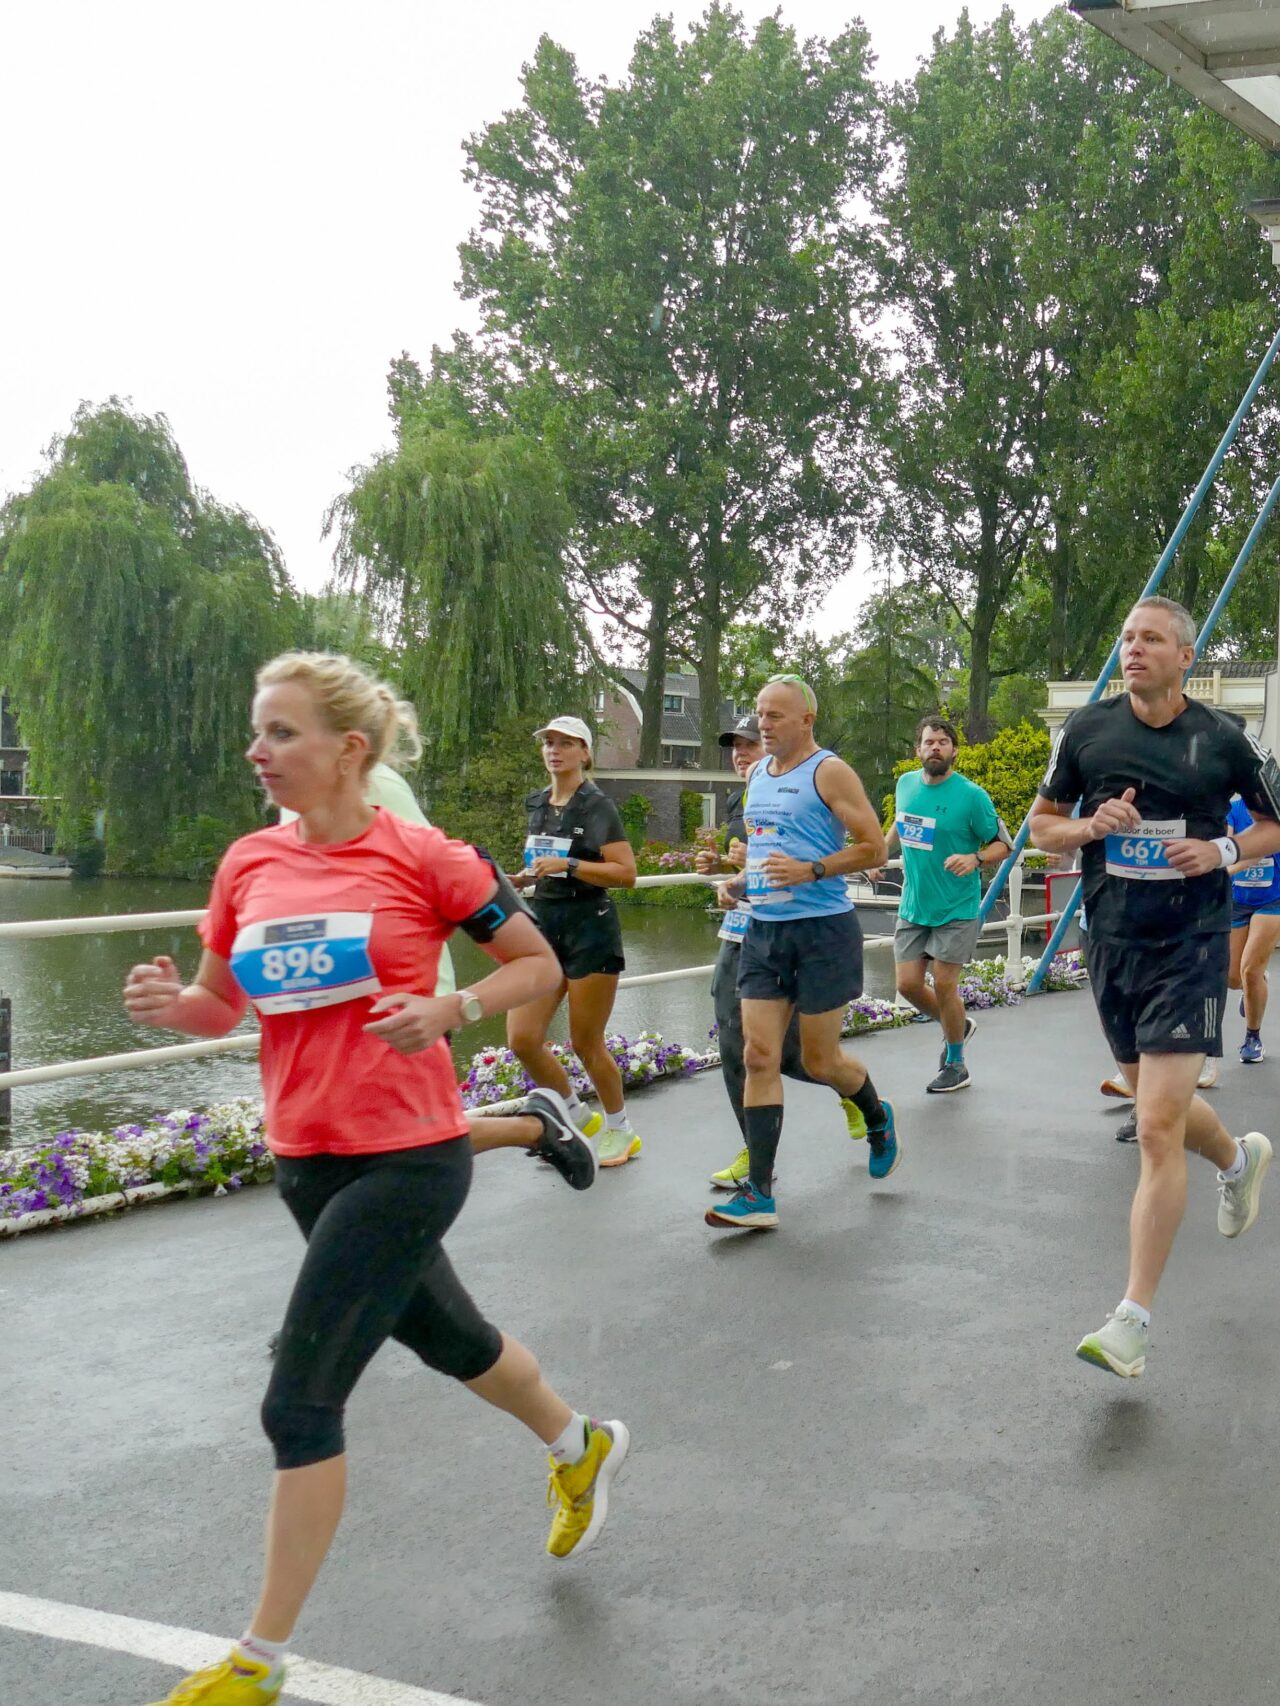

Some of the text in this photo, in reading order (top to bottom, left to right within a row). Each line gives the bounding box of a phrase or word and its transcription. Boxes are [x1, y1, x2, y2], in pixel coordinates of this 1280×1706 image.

[903, 824, 924, 838] 792
[1121, 840, 1163, 860] 667
[261, 943, 335, 982] 896
